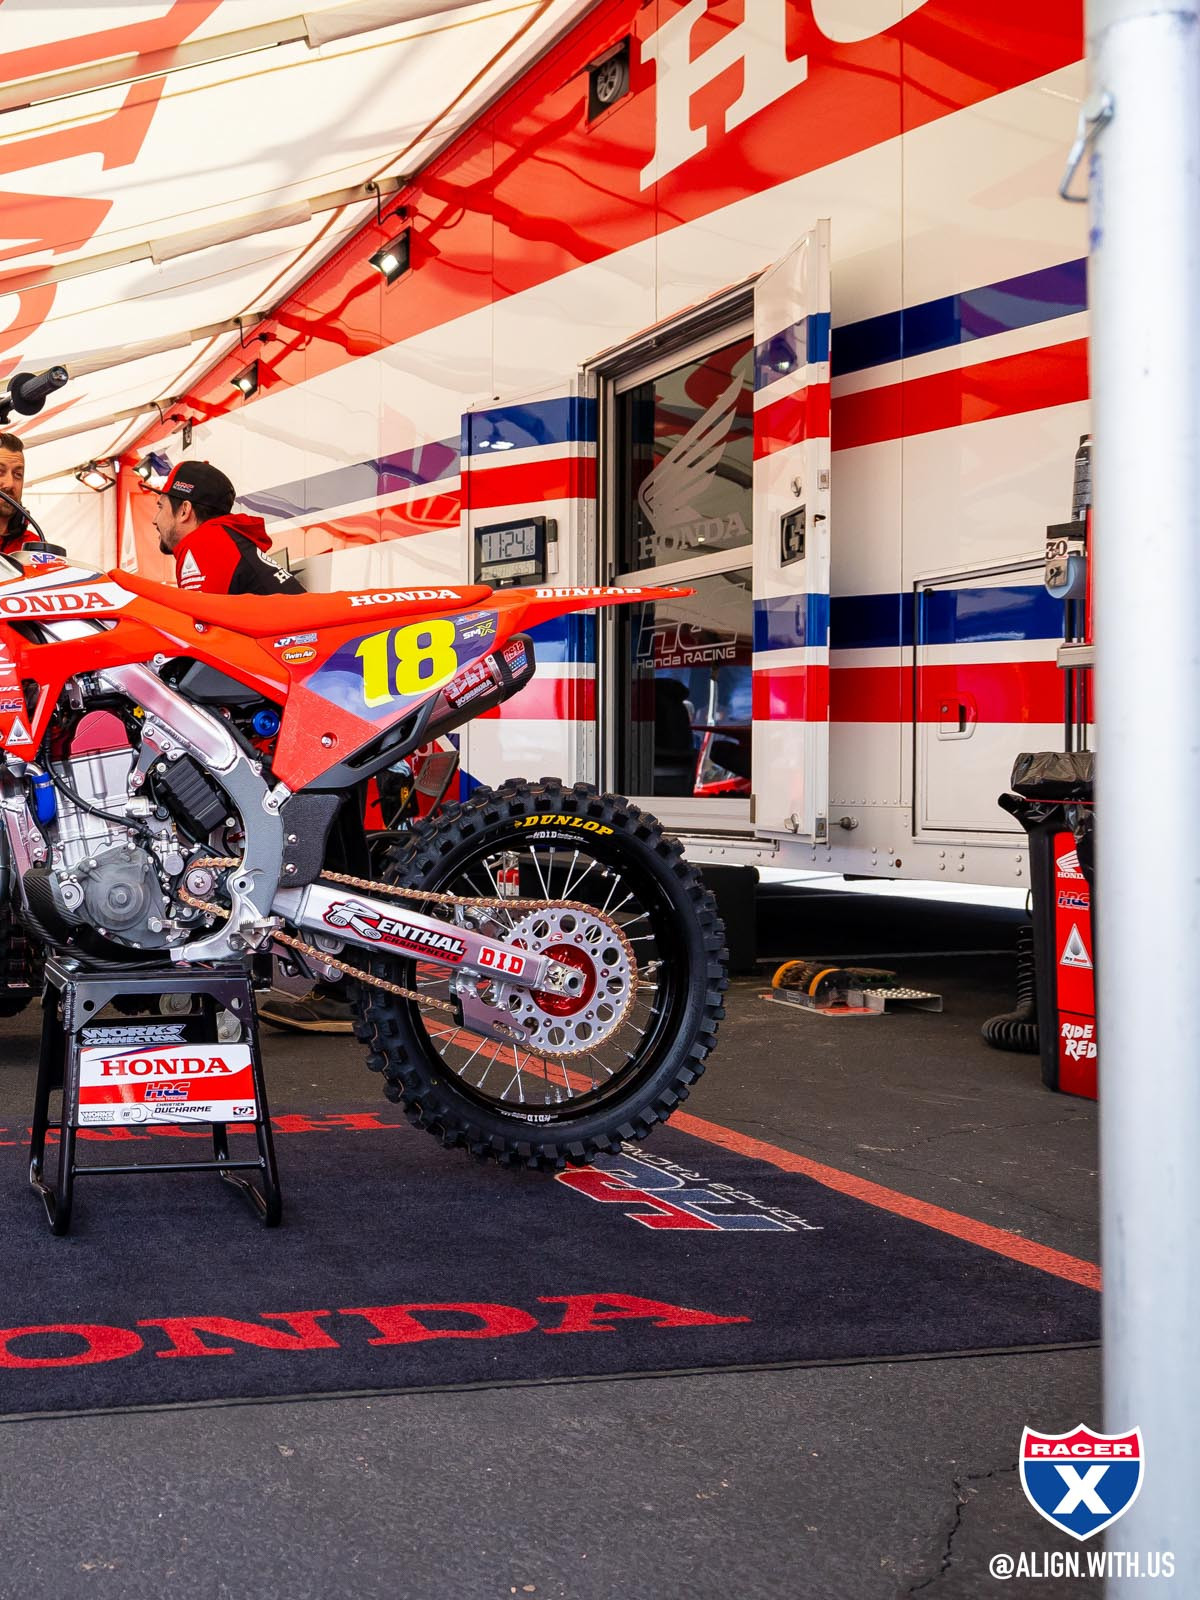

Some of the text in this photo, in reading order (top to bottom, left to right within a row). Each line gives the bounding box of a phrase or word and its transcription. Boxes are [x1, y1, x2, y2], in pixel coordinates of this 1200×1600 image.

[488, 529, 525, 560] 11:24
[637, 511, 749, 560] HONDA
[32, 554, 56, 563] VP
[1046, 540, 1068, 560] 30
[347, 589, 462, 607] HONDA
[462, 621, 496, 640] SMX
[285, 652, 302, 660] Twin
[355, 619, 458, 708] 18
[637, 647, 736, 669] Honda RACING
[522, 815, 615, 835] DUNLOP
[1058, 891, 1090, 907] HRC
[322, 899, 466, 954] RENTHAL
[383, 935, 460, 962] CHAINWHEELS
[481, 948, 524, 974] D.I.D
[81, 1024, 186, 1037] WORKS
[82, 1035, 187, 1045] CONNECTION
[1061, 1022, 1094, 1040] RIDE
[1065, 1039, 1097, 1061] RED
[100, 1057, 233, 1077] HONDA
[144, 1082, 191, 1097] HRC
[154, 1105, 213, 1113] DUCHARME
